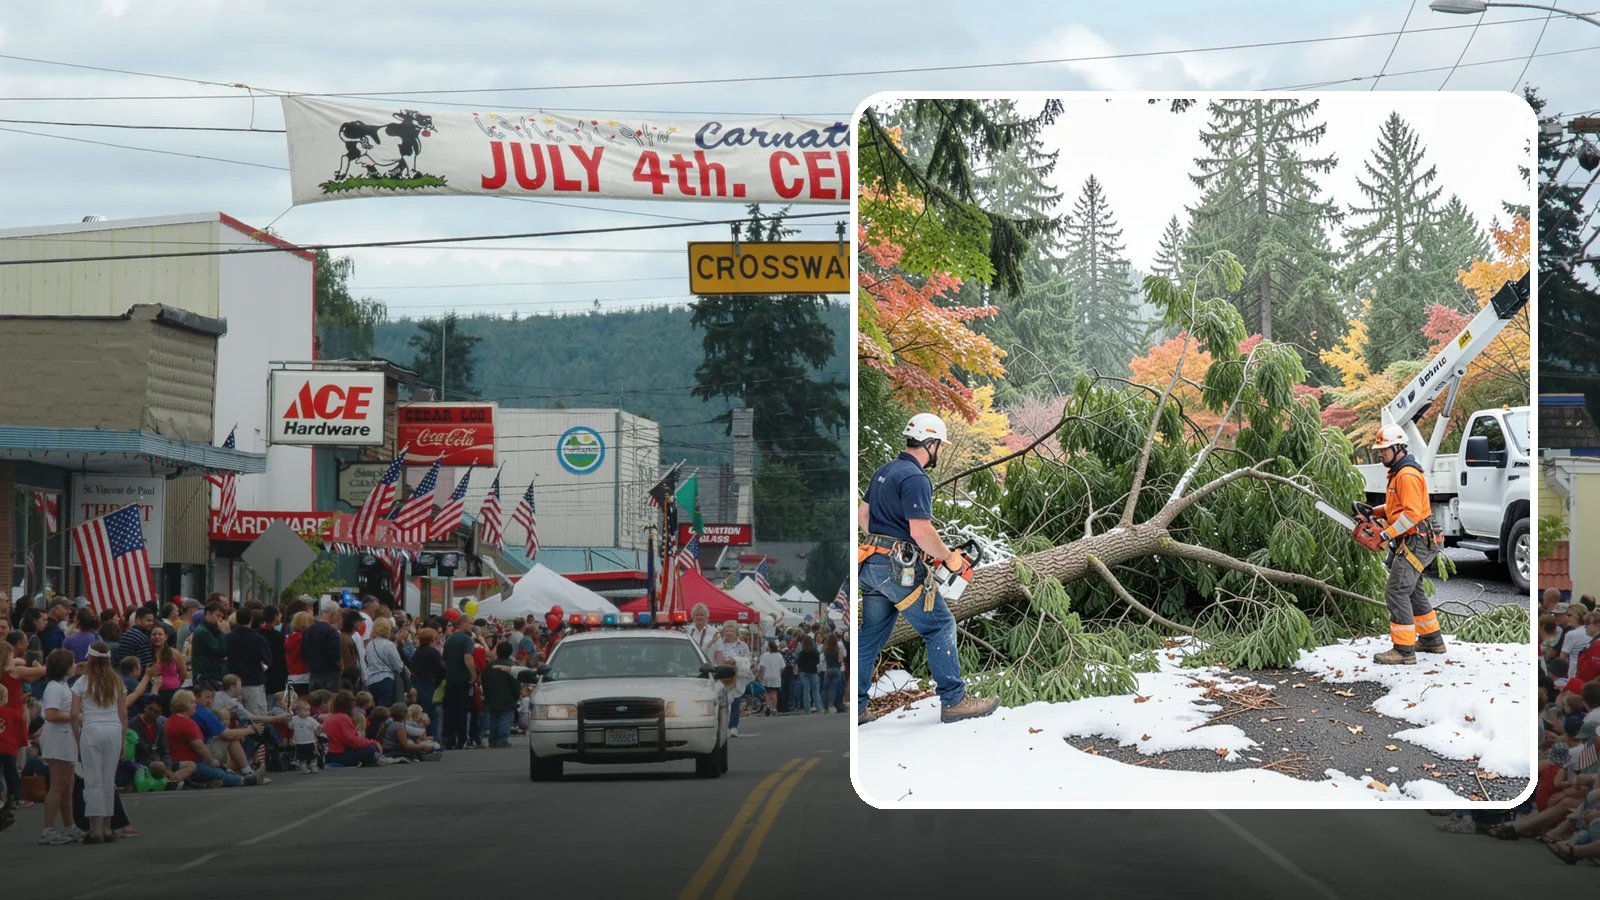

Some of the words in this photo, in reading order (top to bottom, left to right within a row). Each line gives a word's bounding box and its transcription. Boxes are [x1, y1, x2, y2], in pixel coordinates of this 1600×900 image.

[481, 141, 604, 192] JULY
[632, 150, 746, 197] 4th.
[697, 253, 850, 280] CROSSWA
[283, 380, 373, 420] ACE
[405, 409, 453, 422] CEDAR
[283, 421, 370, 436] Hardware
[416, 428, 477, 446] Coca-Cola
[353, 466, 385, 480] Simpl
[83, 485, 93, 494] St.
[95, 485, 124, 494] Vincent
[126, 486, 136, 494] de
[137, 486, 155, 495] Paul
[80, 503, 154, 521] THT
[688, 526, 741, 535] CRNATION
[699, 535, 730, 543] GLASS
